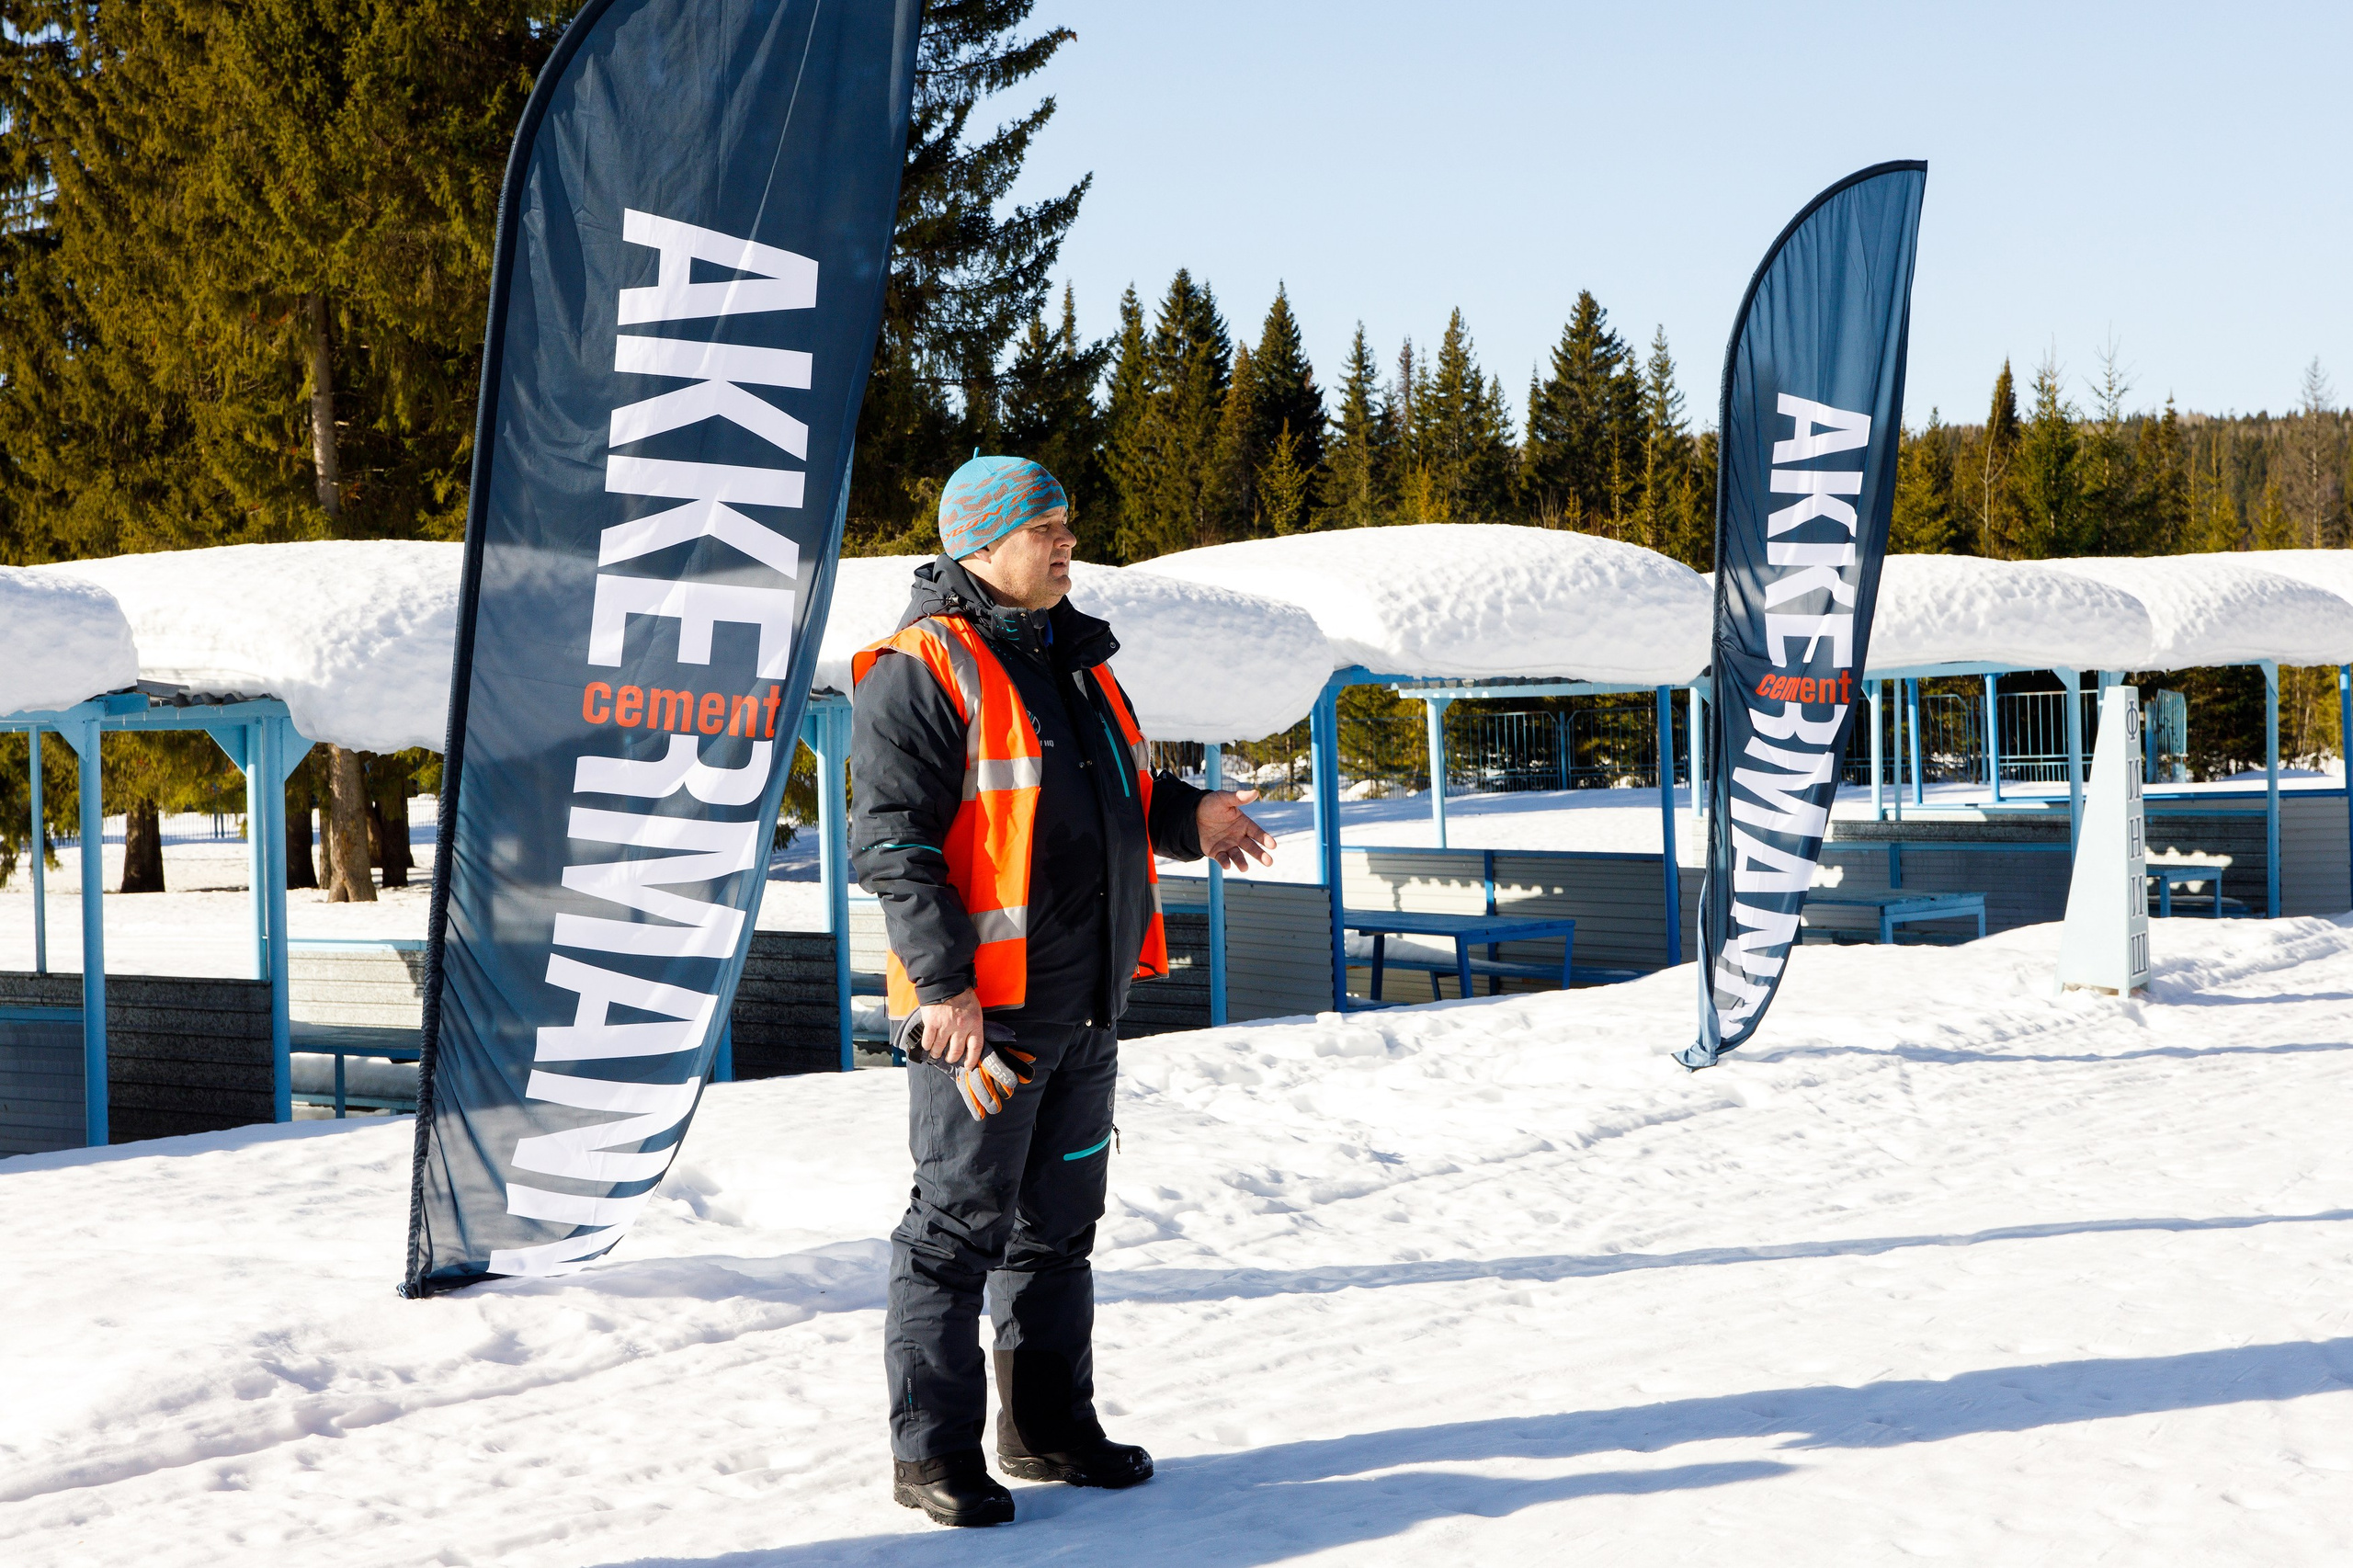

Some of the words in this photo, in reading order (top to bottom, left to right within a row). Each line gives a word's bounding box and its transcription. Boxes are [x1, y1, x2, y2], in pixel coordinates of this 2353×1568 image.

[582, 681, 781, 738] cement
[1755, 670, 1853, 704] cement
[2125, 699, 2148, 977] ФИНИШ
